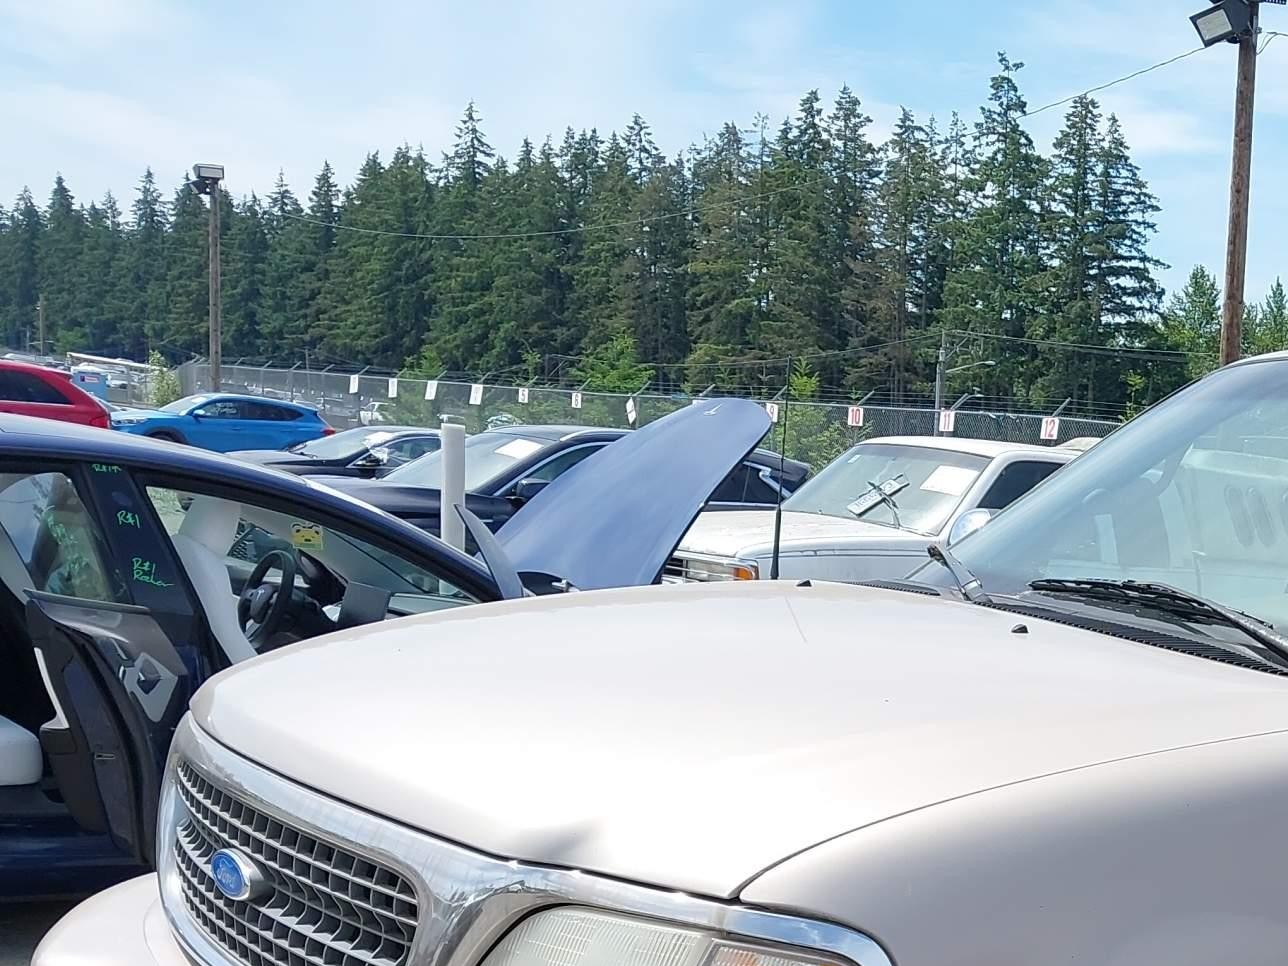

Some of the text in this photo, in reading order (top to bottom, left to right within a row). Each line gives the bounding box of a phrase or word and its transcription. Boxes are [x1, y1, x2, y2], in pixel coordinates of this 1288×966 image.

[850, 406, 861, 425] 10
[942, 411, 952, 431] 11
[1043, 419, 1057, 438] 12
